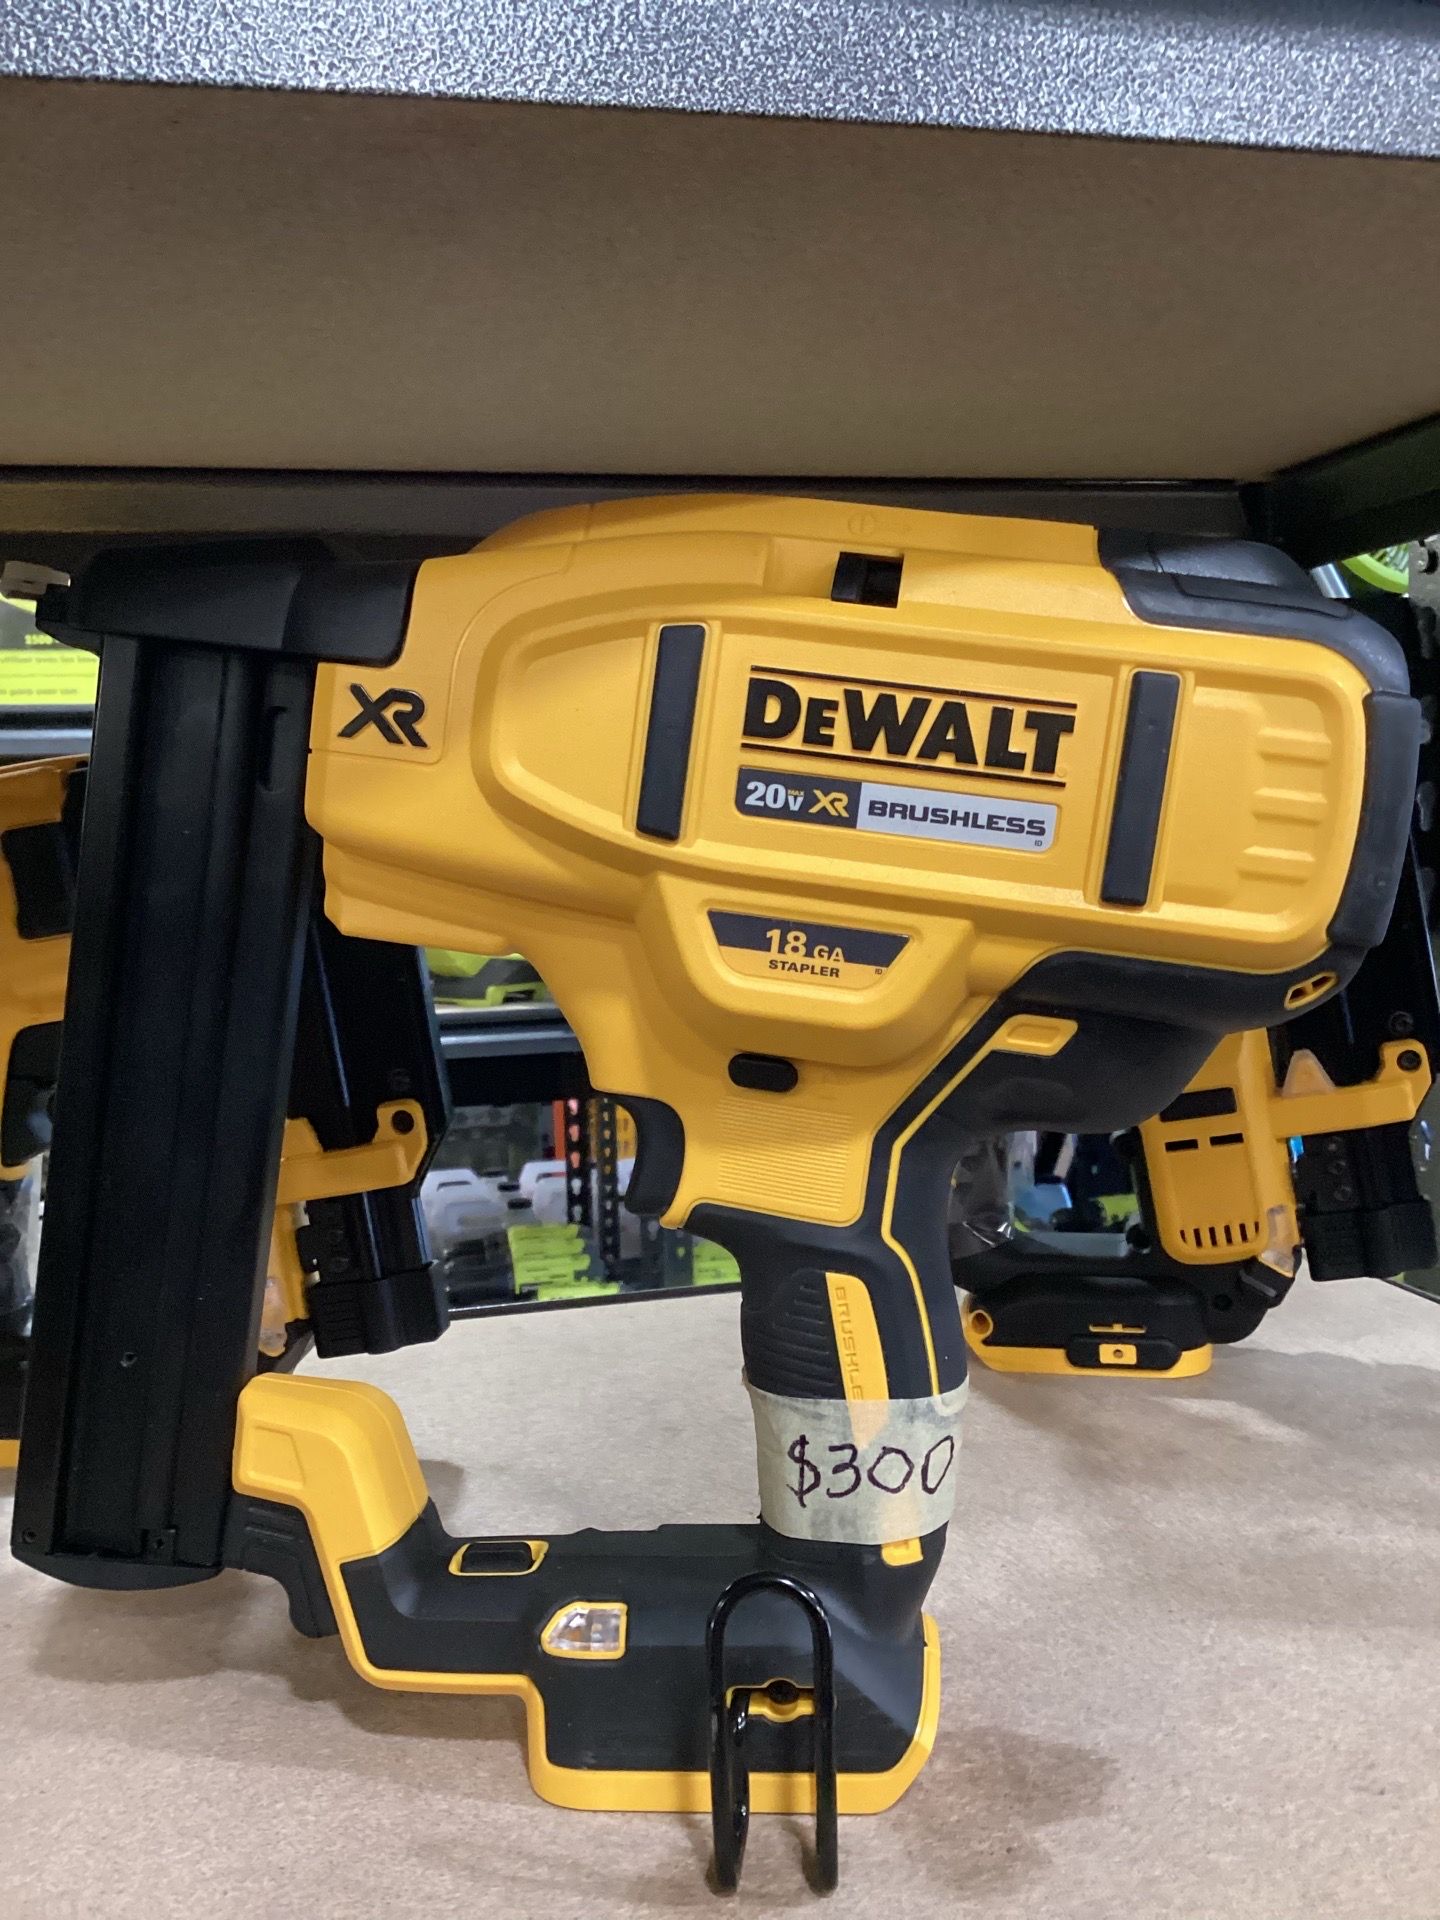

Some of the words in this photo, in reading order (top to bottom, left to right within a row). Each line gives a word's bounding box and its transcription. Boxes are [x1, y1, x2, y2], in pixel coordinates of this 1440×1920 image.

[337, 683, 428, 748] XR
[808, 789, 850, 818] XR
[868, 800, 1047, 837] BRUSHLESS
[766, 928, 807, 958] 18
[813, 945, 845, 963] GA
[768, 959, 840, 978] STAPLER
[834, 1286, 864, 1401] BRUSHLE
[786, 1434, 955, 1508] $300
